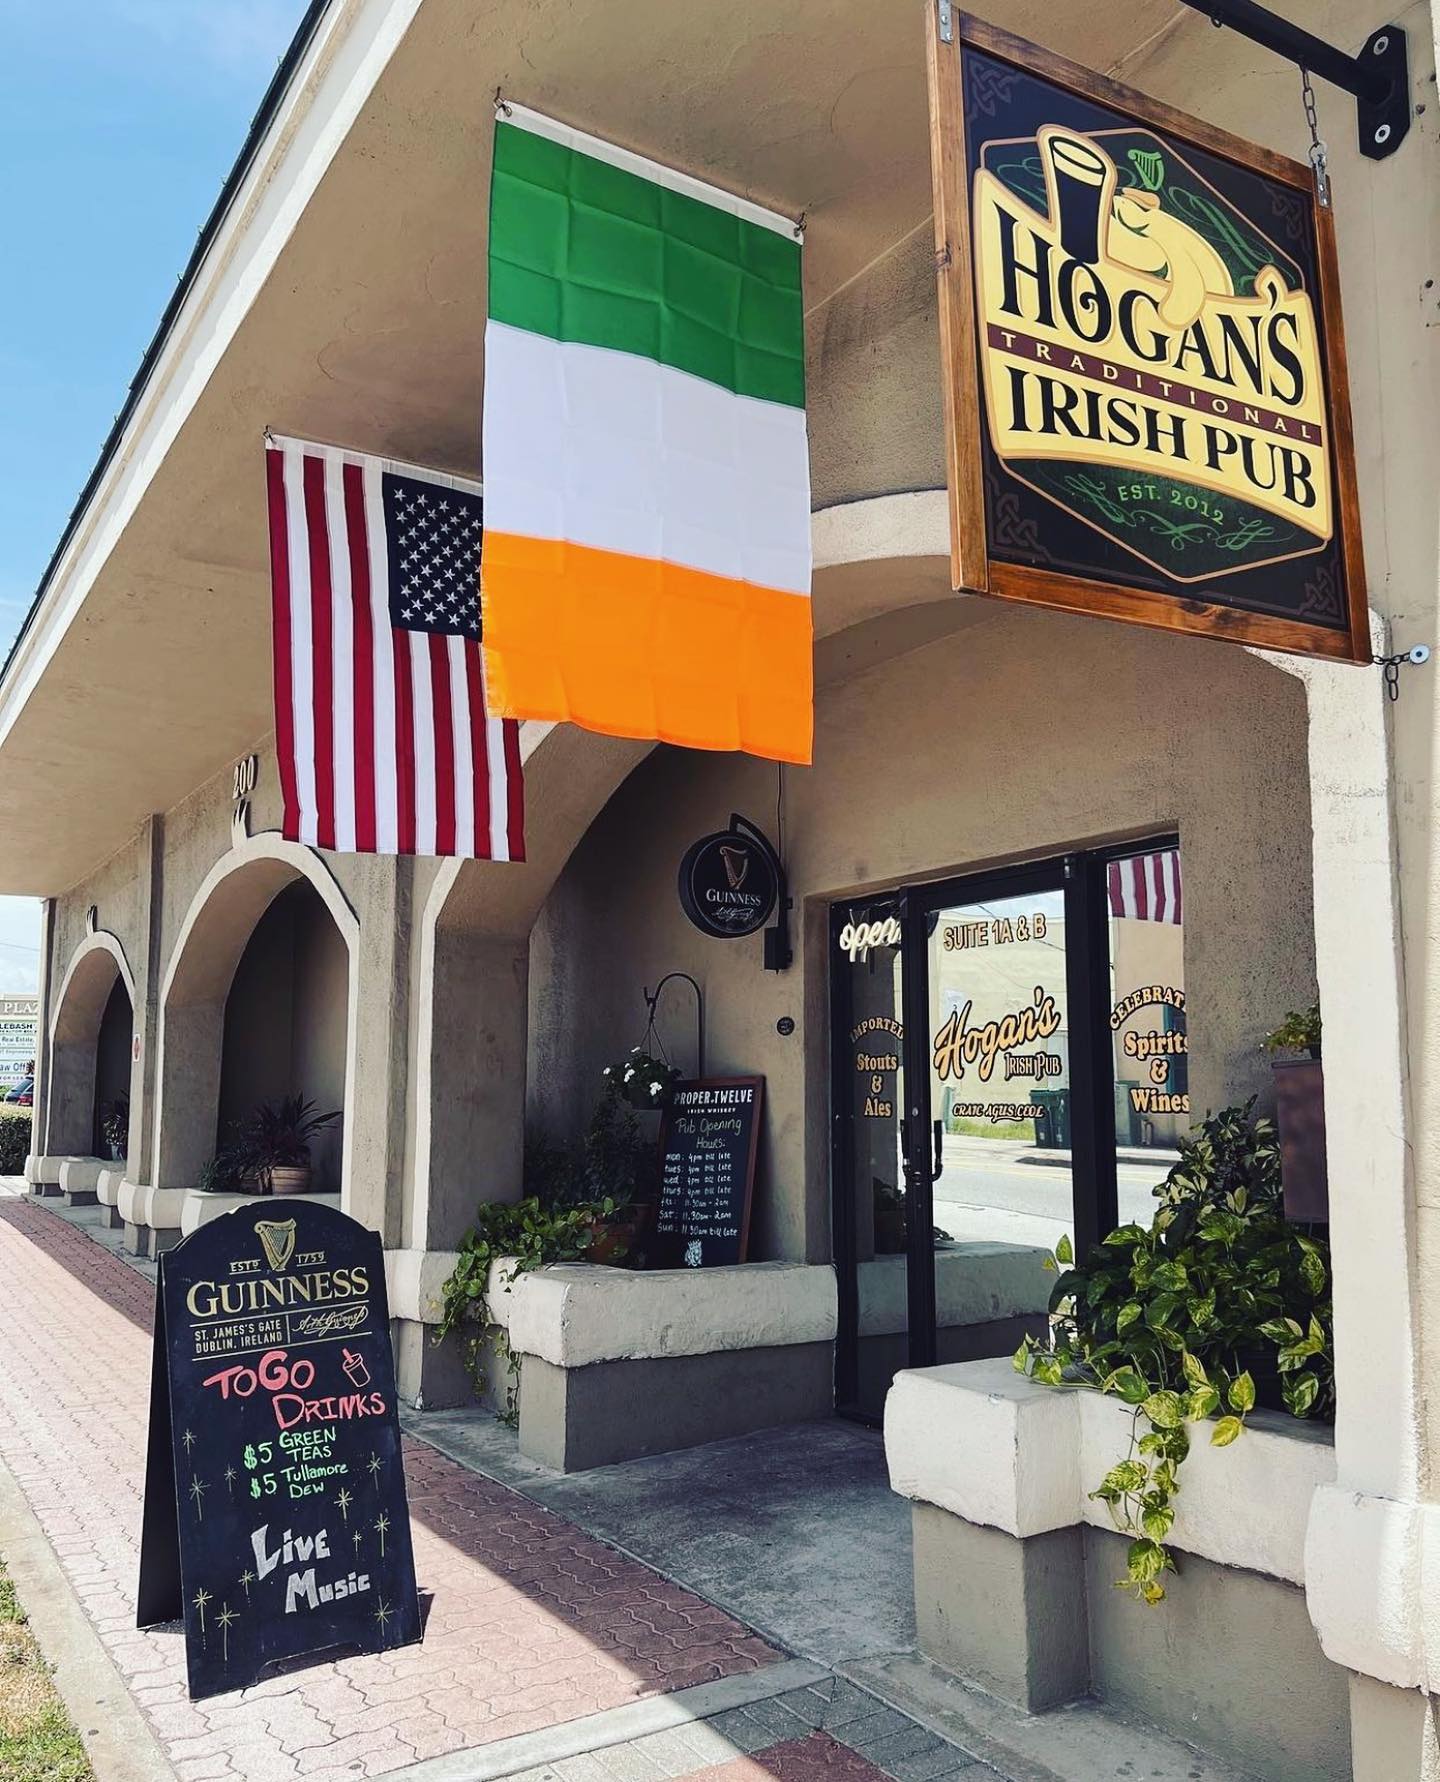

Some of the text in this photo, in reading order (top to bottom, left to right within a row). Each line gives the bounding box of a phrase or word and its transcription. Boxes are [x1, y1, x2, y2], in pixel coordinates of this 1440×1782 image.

[993, 200, 1305, 407] HOGAN'S
[1001, 332, 1311, 439] TRADITIONAL
[1004, 365, 1317, 509] IRISH PUB
[1117, 484, 1225, 526] EST. 2012
[706, 888, 761, 907] GUINNESS
[943, 913, 1047, 951] SUITE 1A & B
[1109, 985, 1186, 1031] CELEBRAT
[933, 985, 1061, 1082] Hogan's
[856, 1052, 898, 1072] Stouts
[1004, 1051, 1062, 1081] IRISH PUB
[1150, 1058, 1169, 1084] &
[871, 1074, 883, 1094] &
[863, 1096, 893, 1118] Ales
[1129, 1087, 1190, 1113] Wines
[675, 1117, 742, 1136] Pub Opening
[296, 1251, 325, 1265] 1759
[186, 1266, 370, 1317] GUINNESS
[194, 1319, 282, 1342] ST. JAMES'S GATE
[240, 1331, 284, 1348] IRELAND
[272, 1392, 386, 1430] DRINKS
[243, 1426, 337, 1470] $5 GREEN
[285, 1444, 333, 1463] TEAS
[250, 1461, 350, 1499] $5 Tullamore
